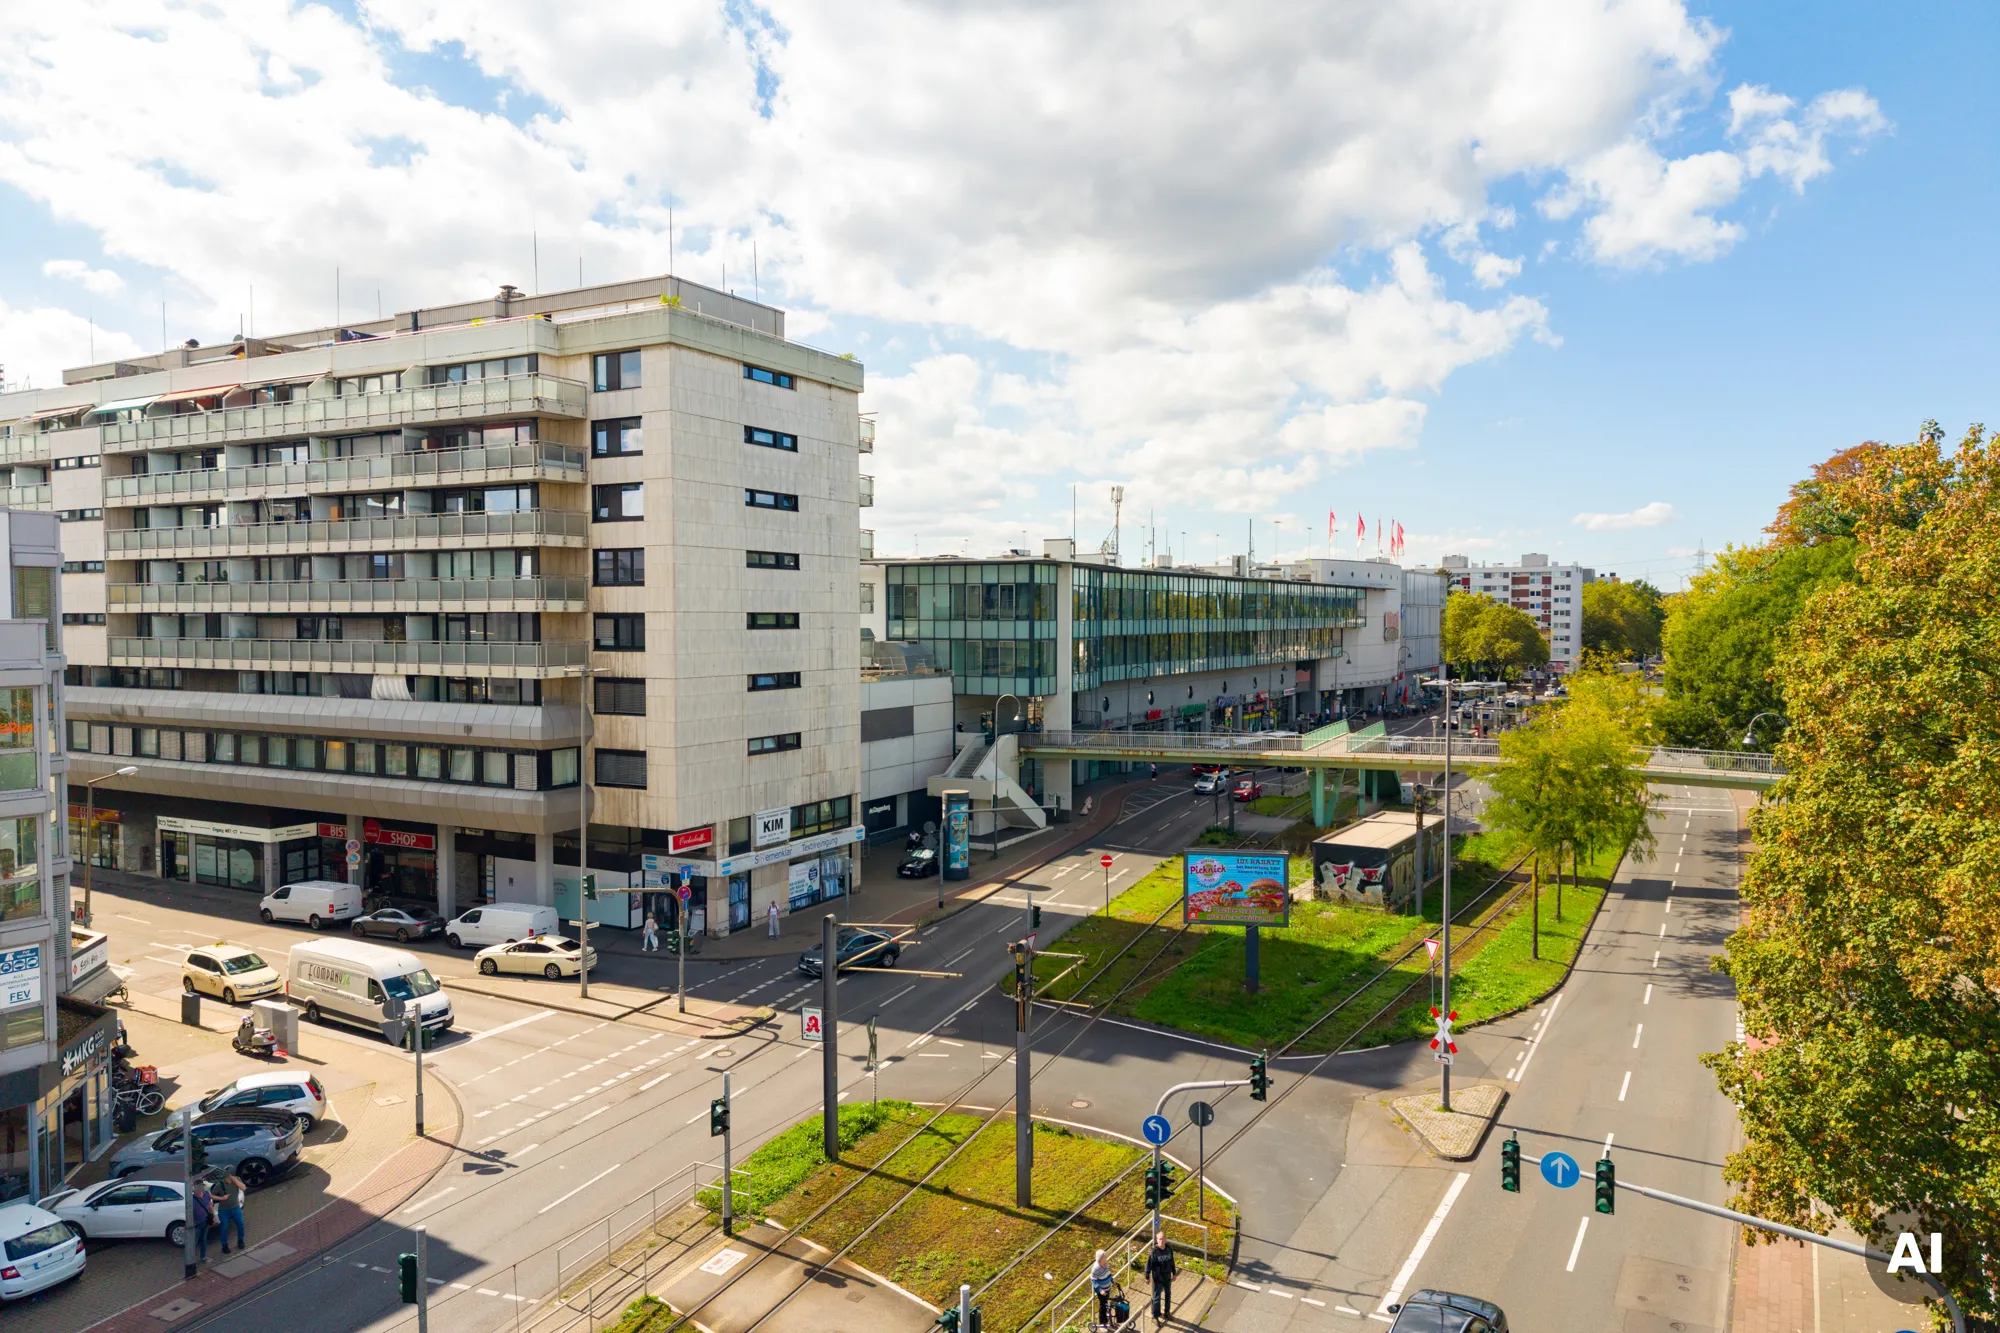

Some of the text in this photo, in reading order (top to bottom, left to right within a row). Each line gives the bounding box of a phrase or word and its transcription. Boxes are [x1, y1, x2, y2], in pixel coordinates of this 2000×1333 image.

[763, 817, 784, 833] KIM
[391, 833, 416, 846] SHOP
[1190, 864, 1227, 875] Picknick
[10, 990, 31, 1001] FEV
[73, 1036, 95, 1067] MKG
